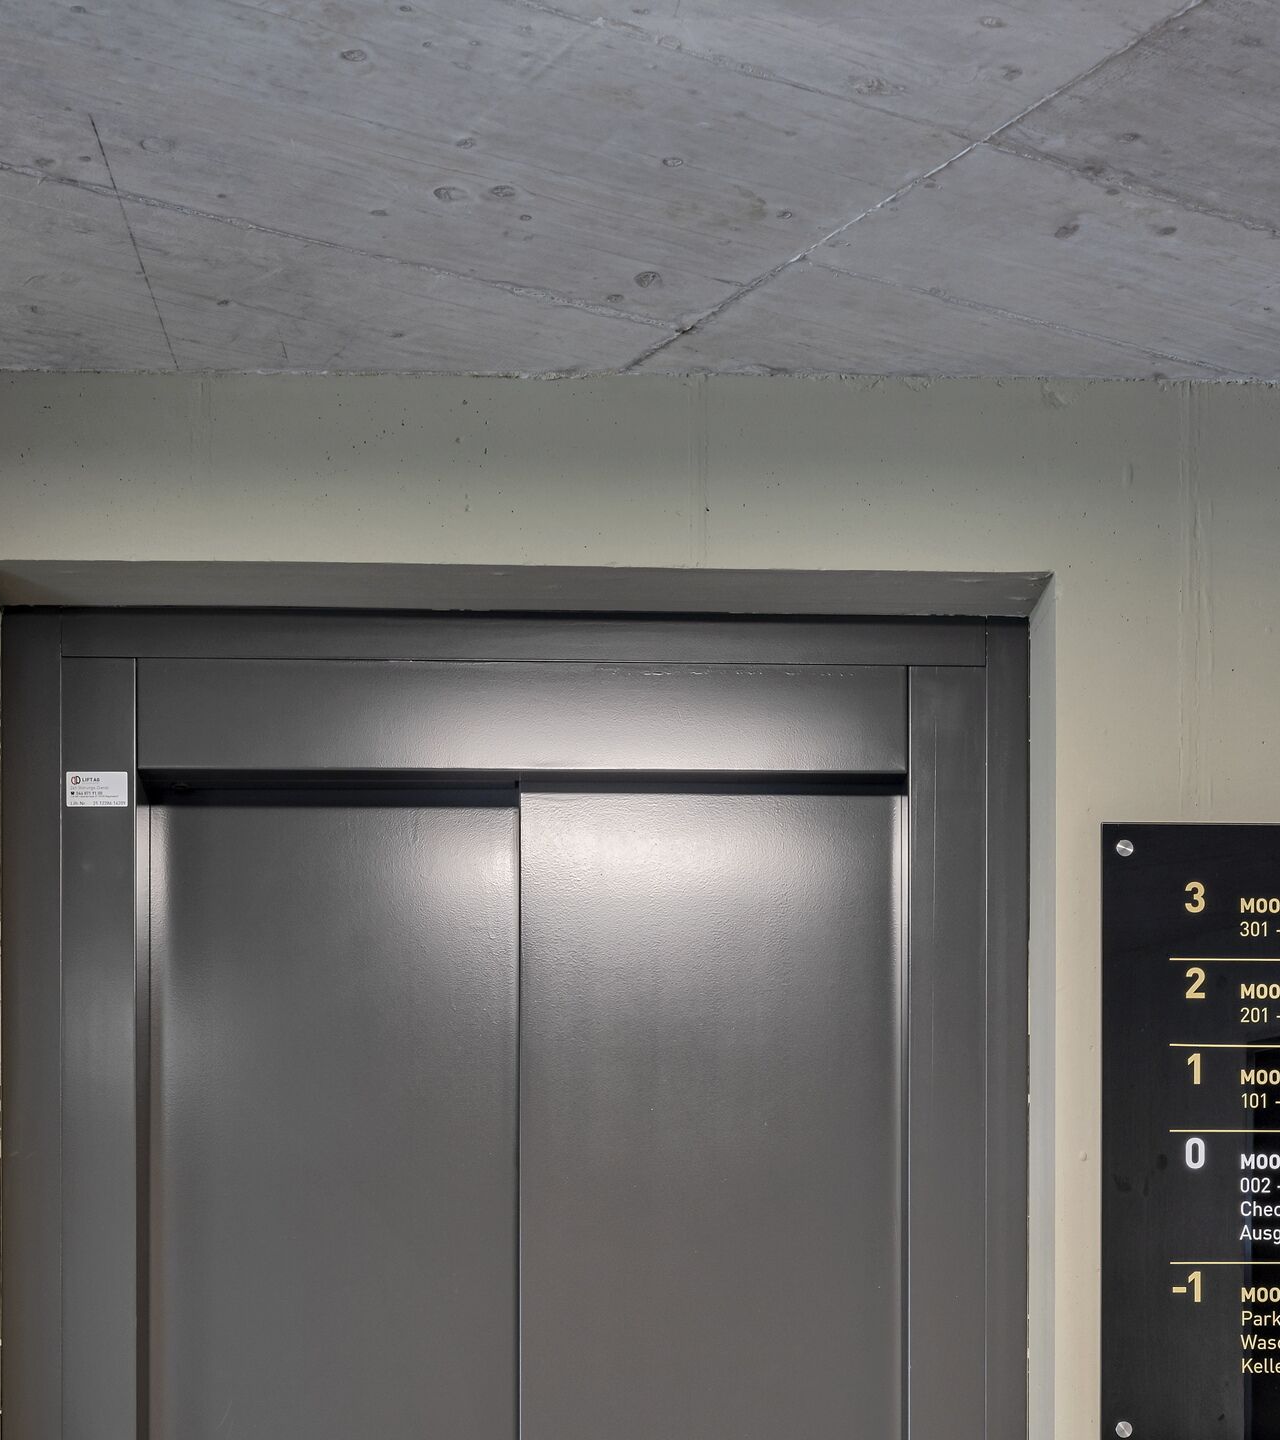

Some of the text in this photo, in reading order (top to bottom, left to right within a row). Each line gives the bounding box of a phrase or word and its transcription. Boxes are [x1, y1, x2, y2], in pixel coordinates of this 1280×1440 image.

[1184, 881, 1206, 914] 3
[1239, 921, 1267, 937] 301
[1185, 966, 1206, 999] 2
[1240, 1007, 1268, 1023] 201
[1187, 1052, 1201, 1085] 1
[1241, 1092, 1266, 1109] 101
[1185, 1137, 1206, 1170] 0
[1240, 1177, 1271, 1194] 002
[1172, 1270, 1202, 1303] -1
